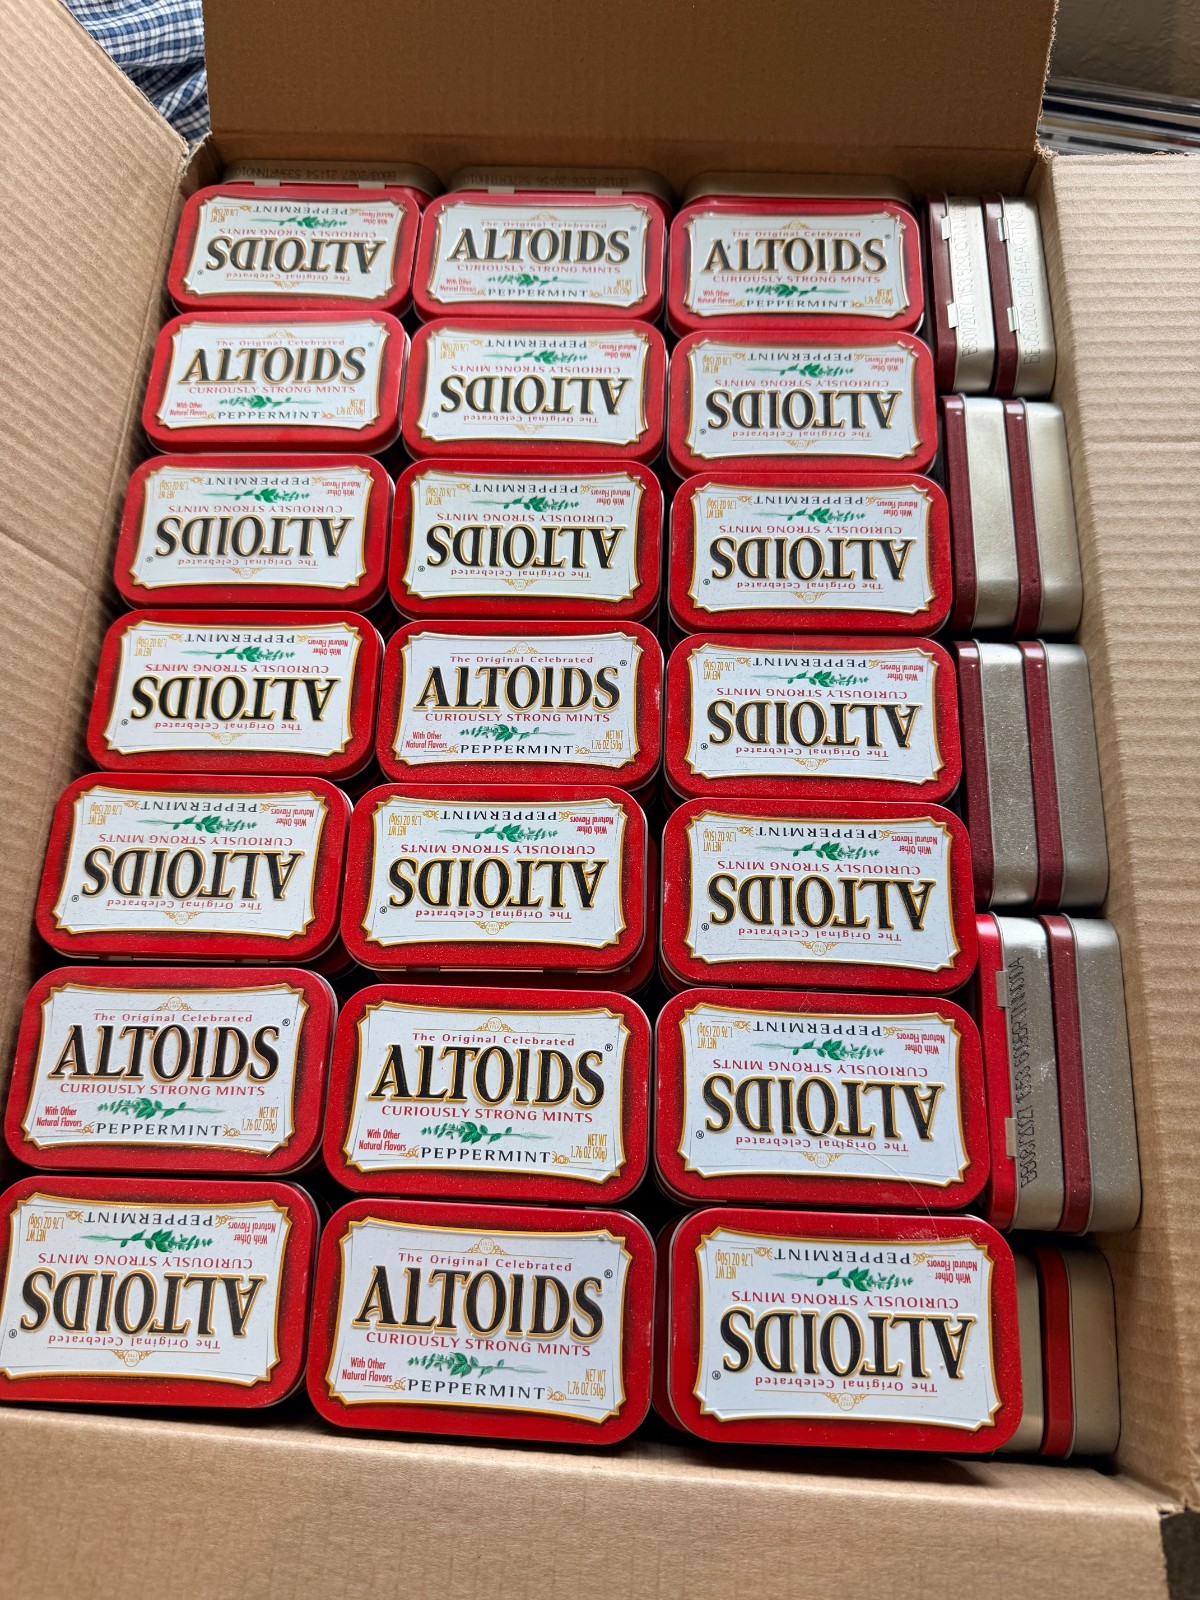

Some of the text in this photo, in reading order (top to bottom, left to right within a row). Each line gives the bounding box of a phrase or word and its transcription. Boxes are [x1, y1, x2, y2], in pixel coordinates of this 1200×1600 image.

[252, 206, 348, 214] PEPPERMINT
[487, 288, 588, 297] PEPPERMINT
[484, 339, 586, 347] PEPPERMINT
[217, 411, 319, 419] PEPPERMINT
[471, 484, 578, 493] PEPPERMINT
[753, 496, 863, 504] PEPPERMINT
[482, 513, 534, 521] STRONG
[538, 514, 613, 522] CURIOUSLY
[517, 569, 564, 577] Original
[183, 634, 295, 642] PEPPERMINT
[476, 656, 524, 664] Original
[752, 657, 866, 667] PEPPERMINT
[424, 713, 502, 721] CURIOUSLY
[605, 730, 623, 739] NET WT
[405, 740, 447, 748] Natural Flavors
[460, 745, 573, 754] PEPPERMINT
[591, 740, 624, 750] 1.76 OZ (50g)
[139, 801, 257, 812] PEPPERMINT
[439, 810, 556, 820] PEPPERMINT
[755, 826, 877, 838] PEPPERMINT
[97, 833, 292, 845] CURIOUSLY STRONG MINTS
[400, 844, 595, 853] CURIOUSLY STRONG MINTS
[717, 860, 920, 874] CURIOUSLY STRONG MINTS
[490, 909, 542, 918] Original
[93, 1013, 252, 1023] The Original Celebrated
[752, 1021, 881, 1036] PEPPERMINT
[412, 1032, 574, 1045] The Original Celebrated
[712, 1058, 927, 1076] CURIOUSLY STRONG MINTS
[59, 1083, 265, 1095] CURIOUSLY STRONG MINTS
[44, 1106, 77, 1116] With Other
[258, 1107, 278, 1117] NET WT
[381, 1105, 593, 1122] CURIOUSLY STRONG MINTS
[36, 1117, 83, 1127] Natural Flavors
[241, 1119, 278, 1132] 1.76 OZ (50g)
[95, 1123, 221, 1135] PEPPERMINT
[735, 1136, 908, 1151] The Original Celebrated
[420, 1147, 550, 1163] PEPPERMINT
[83, 1211, 213, 1225] PEPPERMINT
[36, 1252, 253, 1268] CURIOUSLY STRONG MINTS
[398, 1252, 572, 1271] The Original Celebrated
[773, 1248, 910, 1264] PEPPERMINT
[731, 1290, 958, 1308] CURIOUSLY STRONG MINTS
[365, 1332, 591, 1356] CURIOUSLY STRONG MINTS
[350, 1357, 386, 1370] With Other
[341, 1369, 393, 1382] Natural Flavors
[585, 1369, 606, 1381] NET WT
[407, 1379, 545, 1399] PEPPERMINT
[567, 1381, 607, 1398] 1.76 OZ (50g)
[754, 1376, 936, 1392] The Original Celebrated
